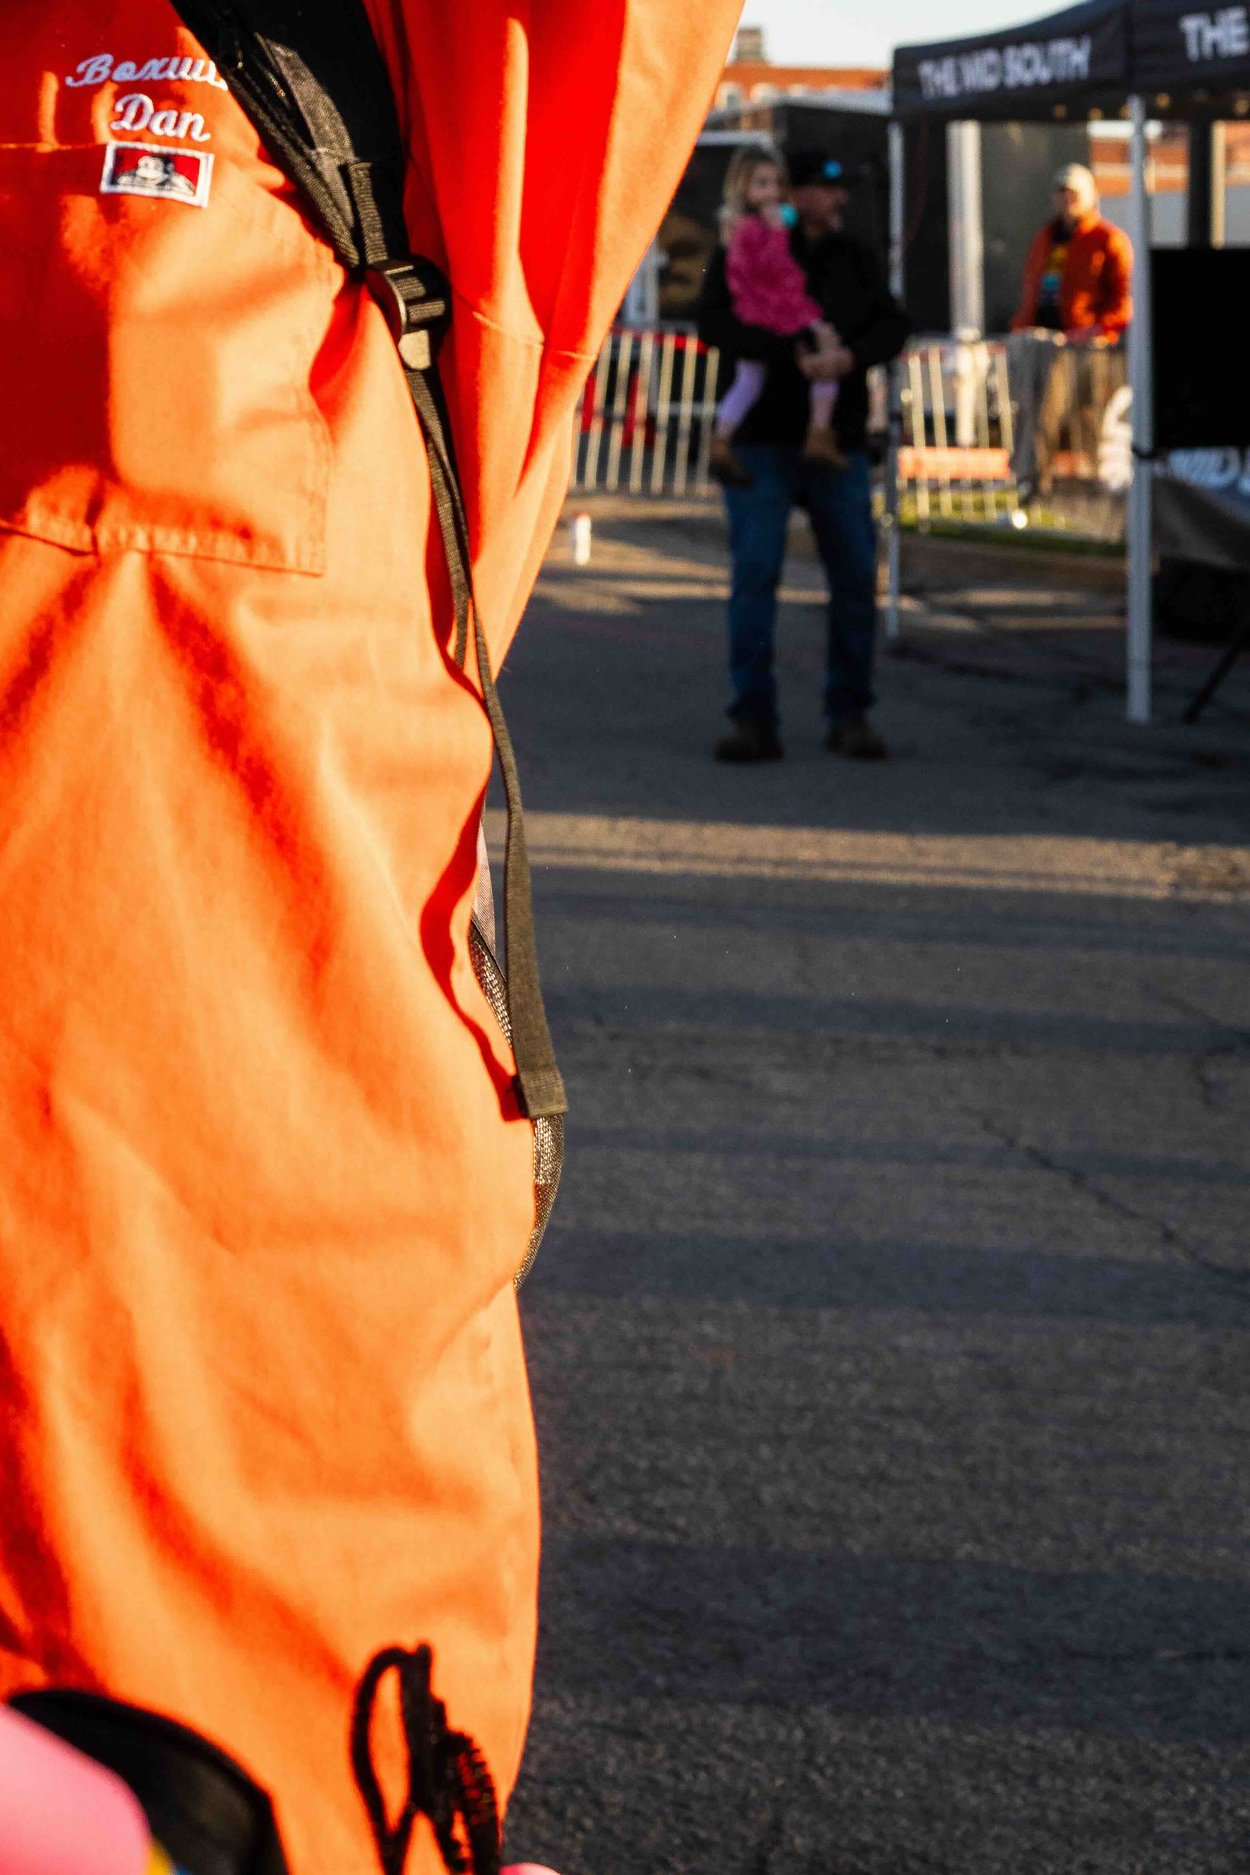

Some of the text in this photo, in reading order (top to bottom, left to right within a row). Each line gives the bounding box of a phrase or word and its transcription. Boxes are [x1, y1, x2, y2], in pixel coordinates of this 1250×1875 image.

[1178, 5, 1250, 63] THE
[1002, 35, 1093, 89] SOUTH
[110, 93, 211, 142] Dan
